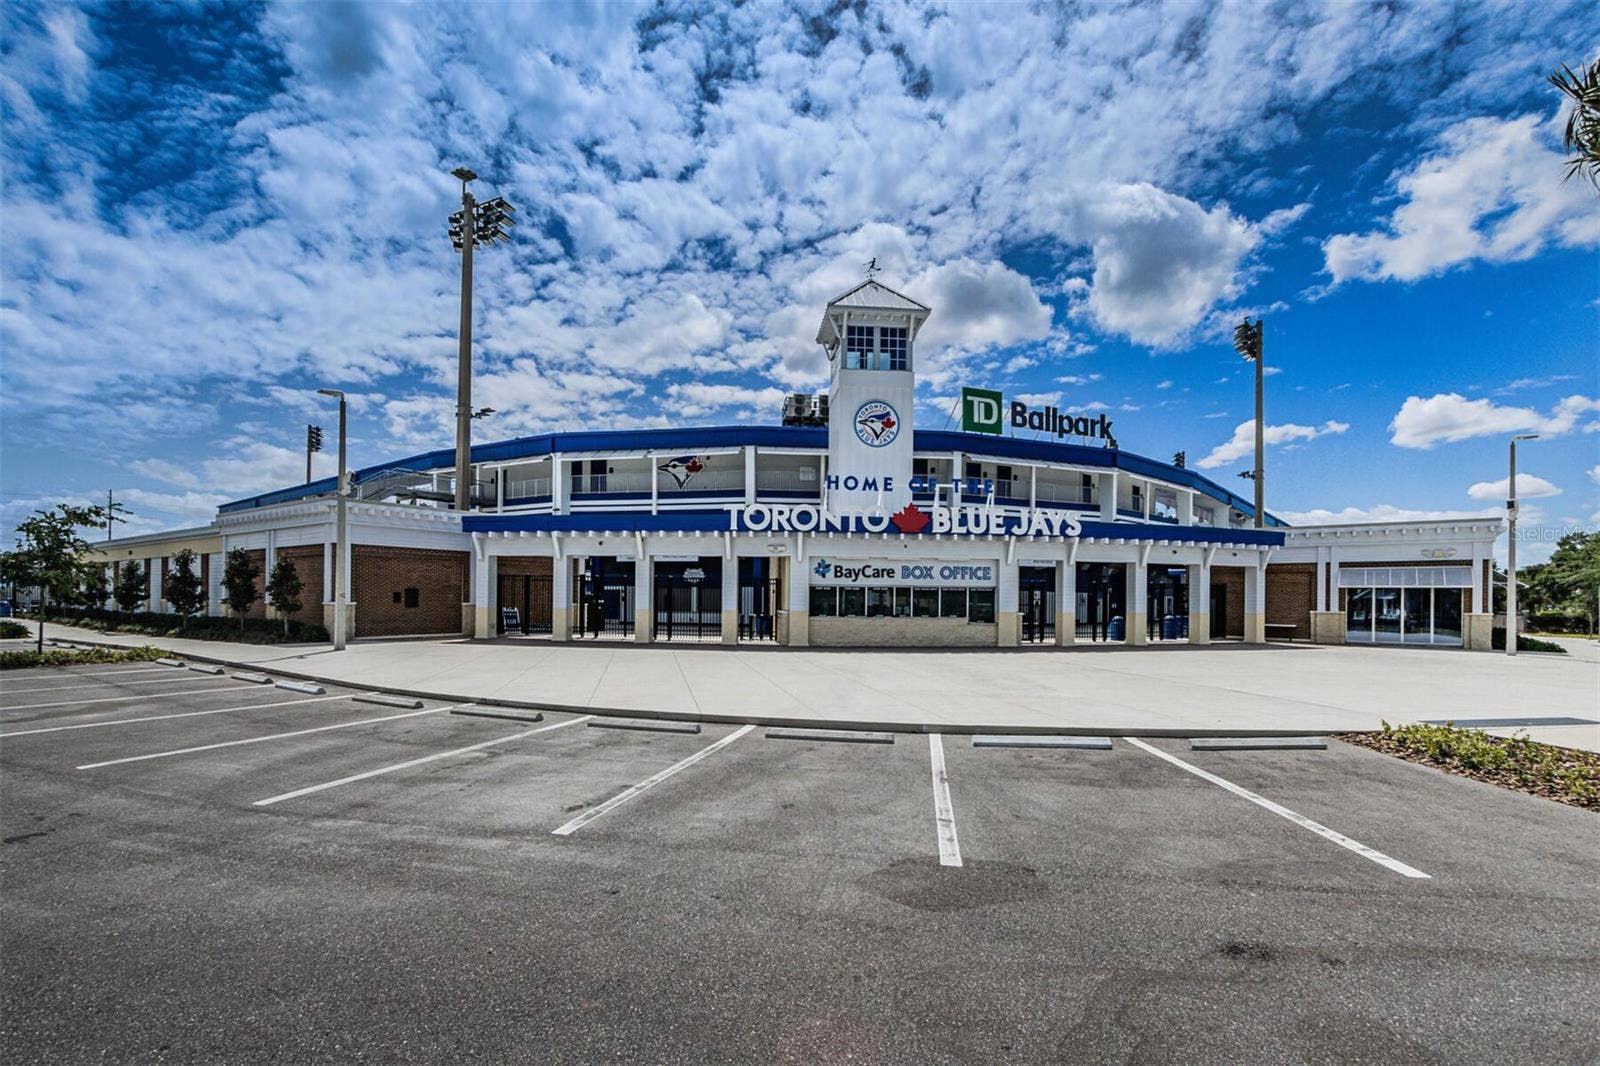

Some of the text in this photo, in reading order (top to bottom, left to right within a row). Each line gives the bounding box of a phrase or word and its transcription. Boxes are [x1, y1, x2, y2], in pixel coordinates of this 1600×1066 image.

[966, 395, 1114, 439] TD Ballpark
[827, 475, 893, 491] HOME
[909, 477, 937, 493] OF
[952, 478, 994, 495] THE
[723, 503, 1082, 536] TORONTO BLUE JAYS
[834, 565, 992, 582] BayCare BOX OFFICE
